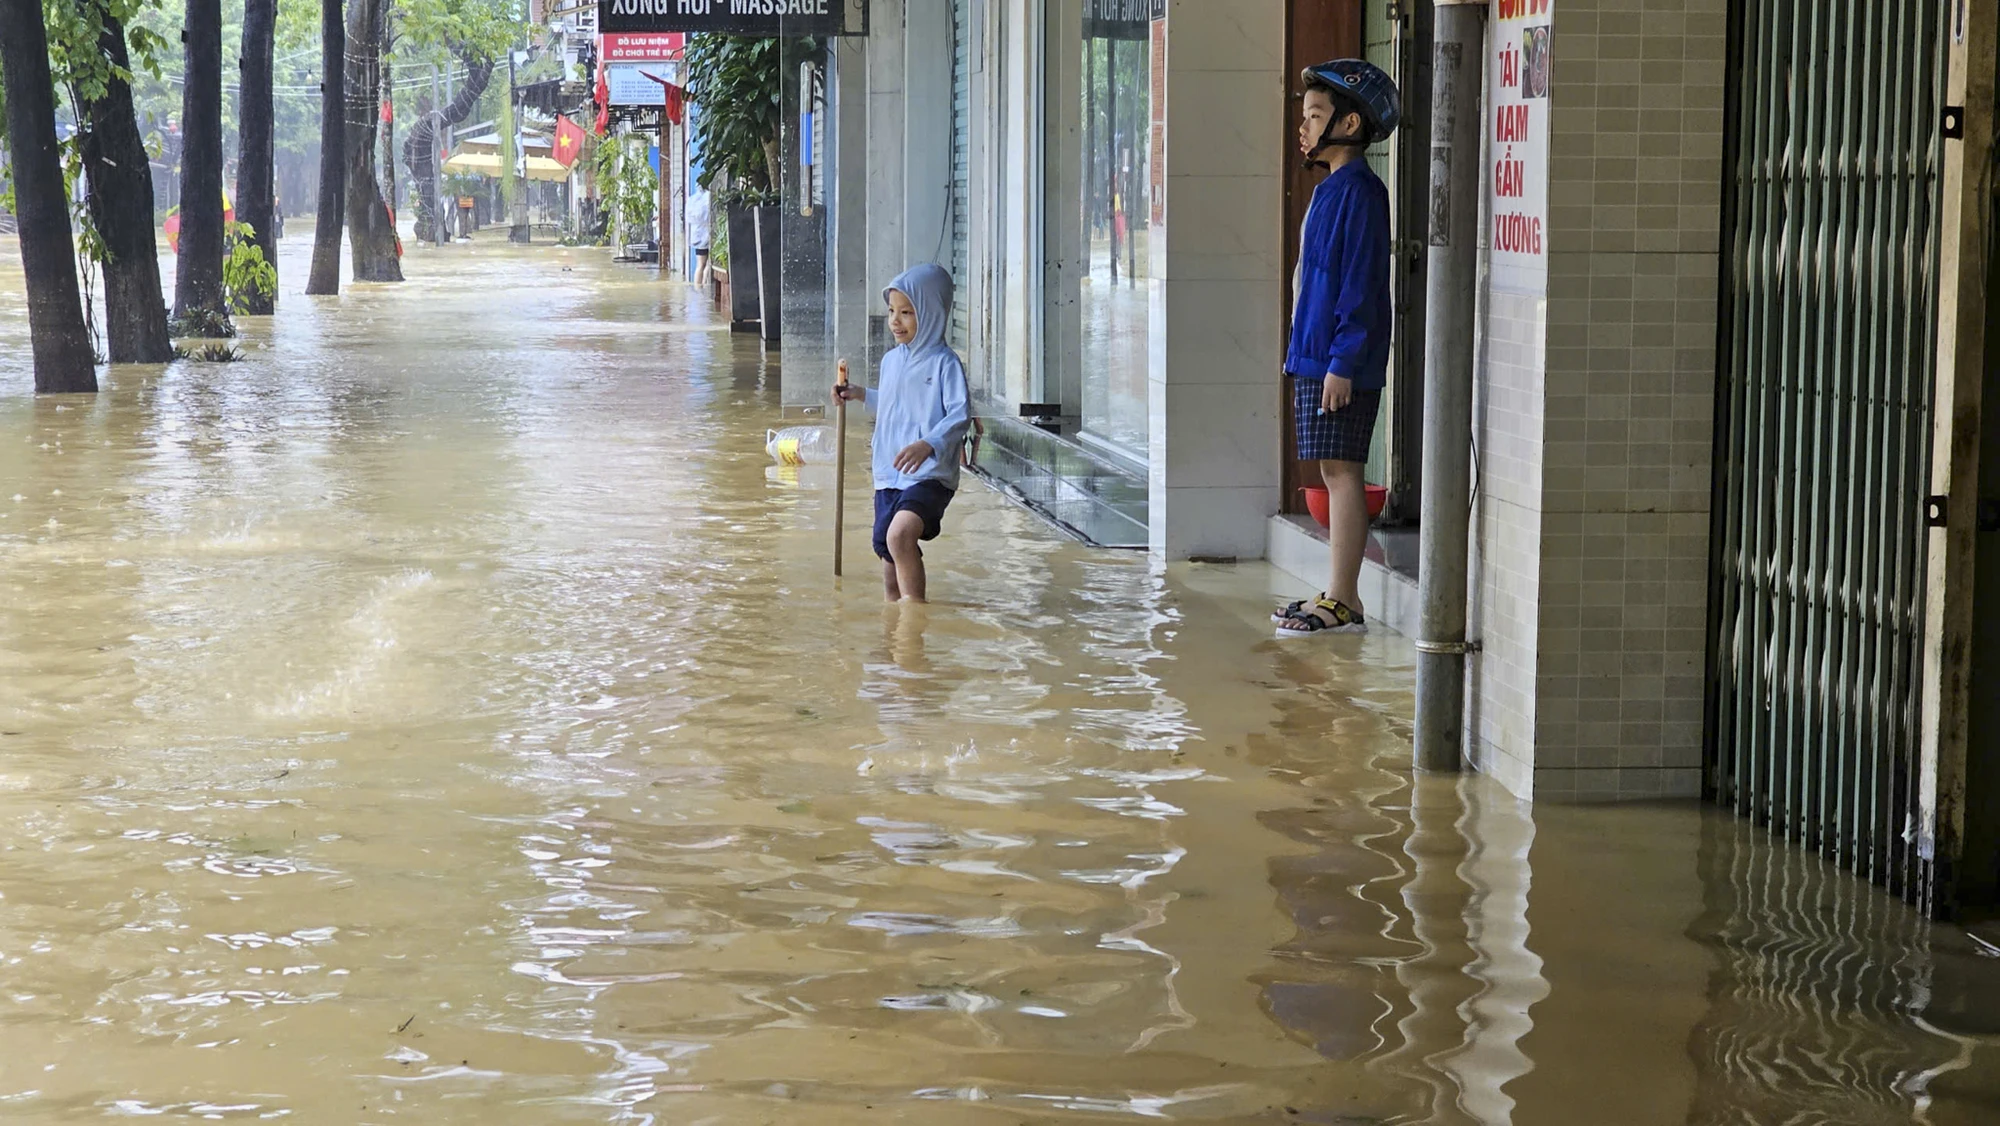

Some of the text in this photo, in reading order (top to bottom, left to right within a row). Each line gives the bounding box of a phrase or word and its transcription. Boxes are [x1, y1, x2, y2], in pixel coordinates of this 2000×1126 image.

[730, 0, 828, 14] MASSAGE
[618, 36, 669, 46] ĐỒ LƯU NIỆM
[612, 47, 624, 57] ĐỒ
[625, 49, 645, 57] CHƠI
[1499, 42, 1518, 87] TÁI
[1494, 211, 1541, 255] XƯƠNG
